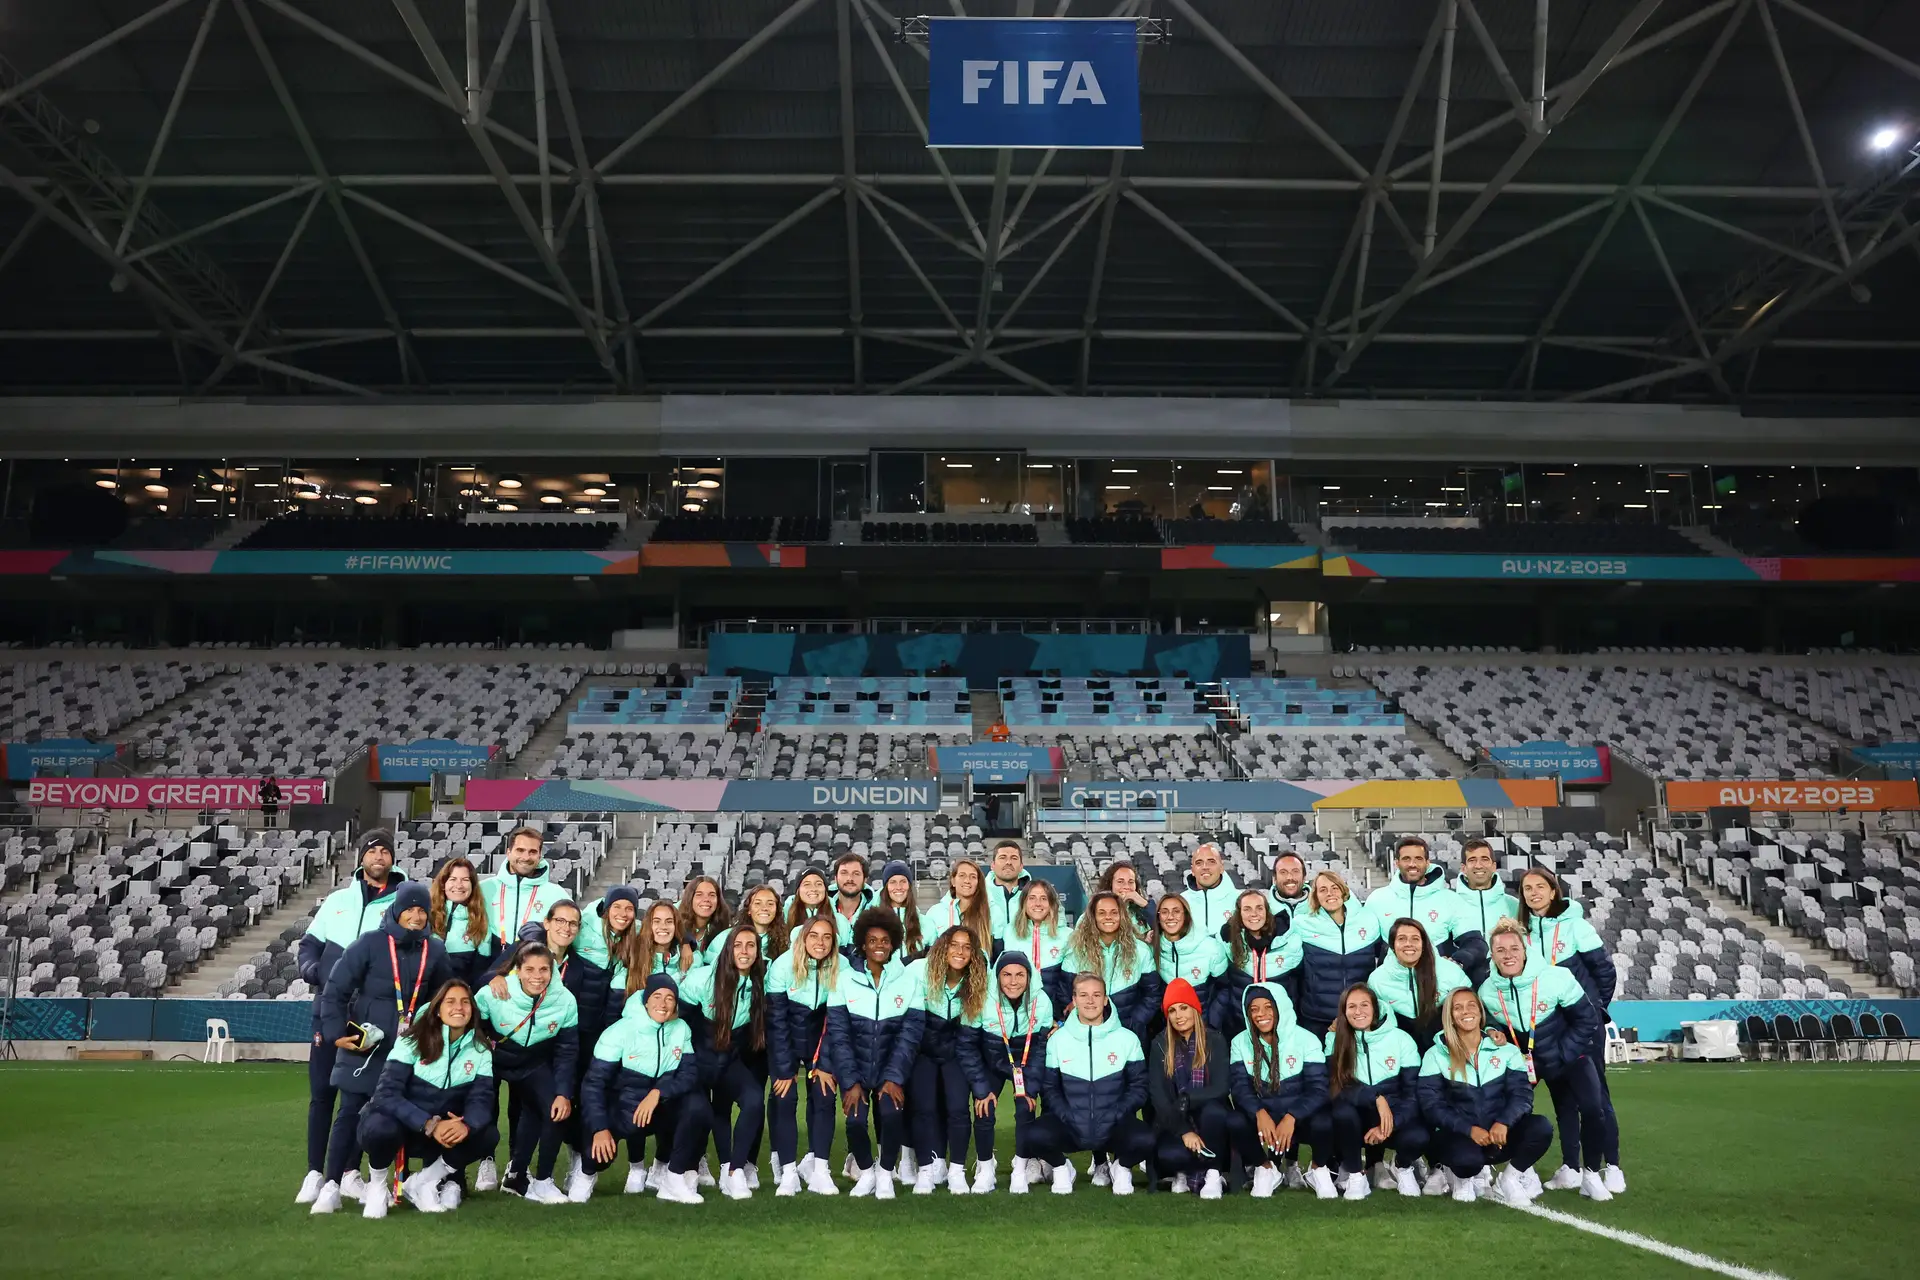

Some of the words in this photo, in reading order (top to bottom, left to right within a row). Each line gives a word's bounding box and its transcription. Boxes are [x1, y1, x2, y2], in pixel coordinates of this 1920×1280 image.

[963, 60, 1107, 104] FIFA
[345, 556, 452, 569] #FIFAWWC
[31, 757, 66, 766] AISLE
[383, 757, 418, 767] AISLE
[422, 757, 446, 767] 307
[449, 758, 457, 767] &
[963, 760, 998, 769] AISLE
[1002, 760, 1028, 769] 306
[1534, 760, 1559, 768] 304
[1562, 760, 1570, 768] &
[1574, 760, 1598, 768] 305
[28, 783, 140, 804] BEYOND
[148, 784, 323, 804] GREATNSS™
[813, 786, 928, 805] DUNEDIN
